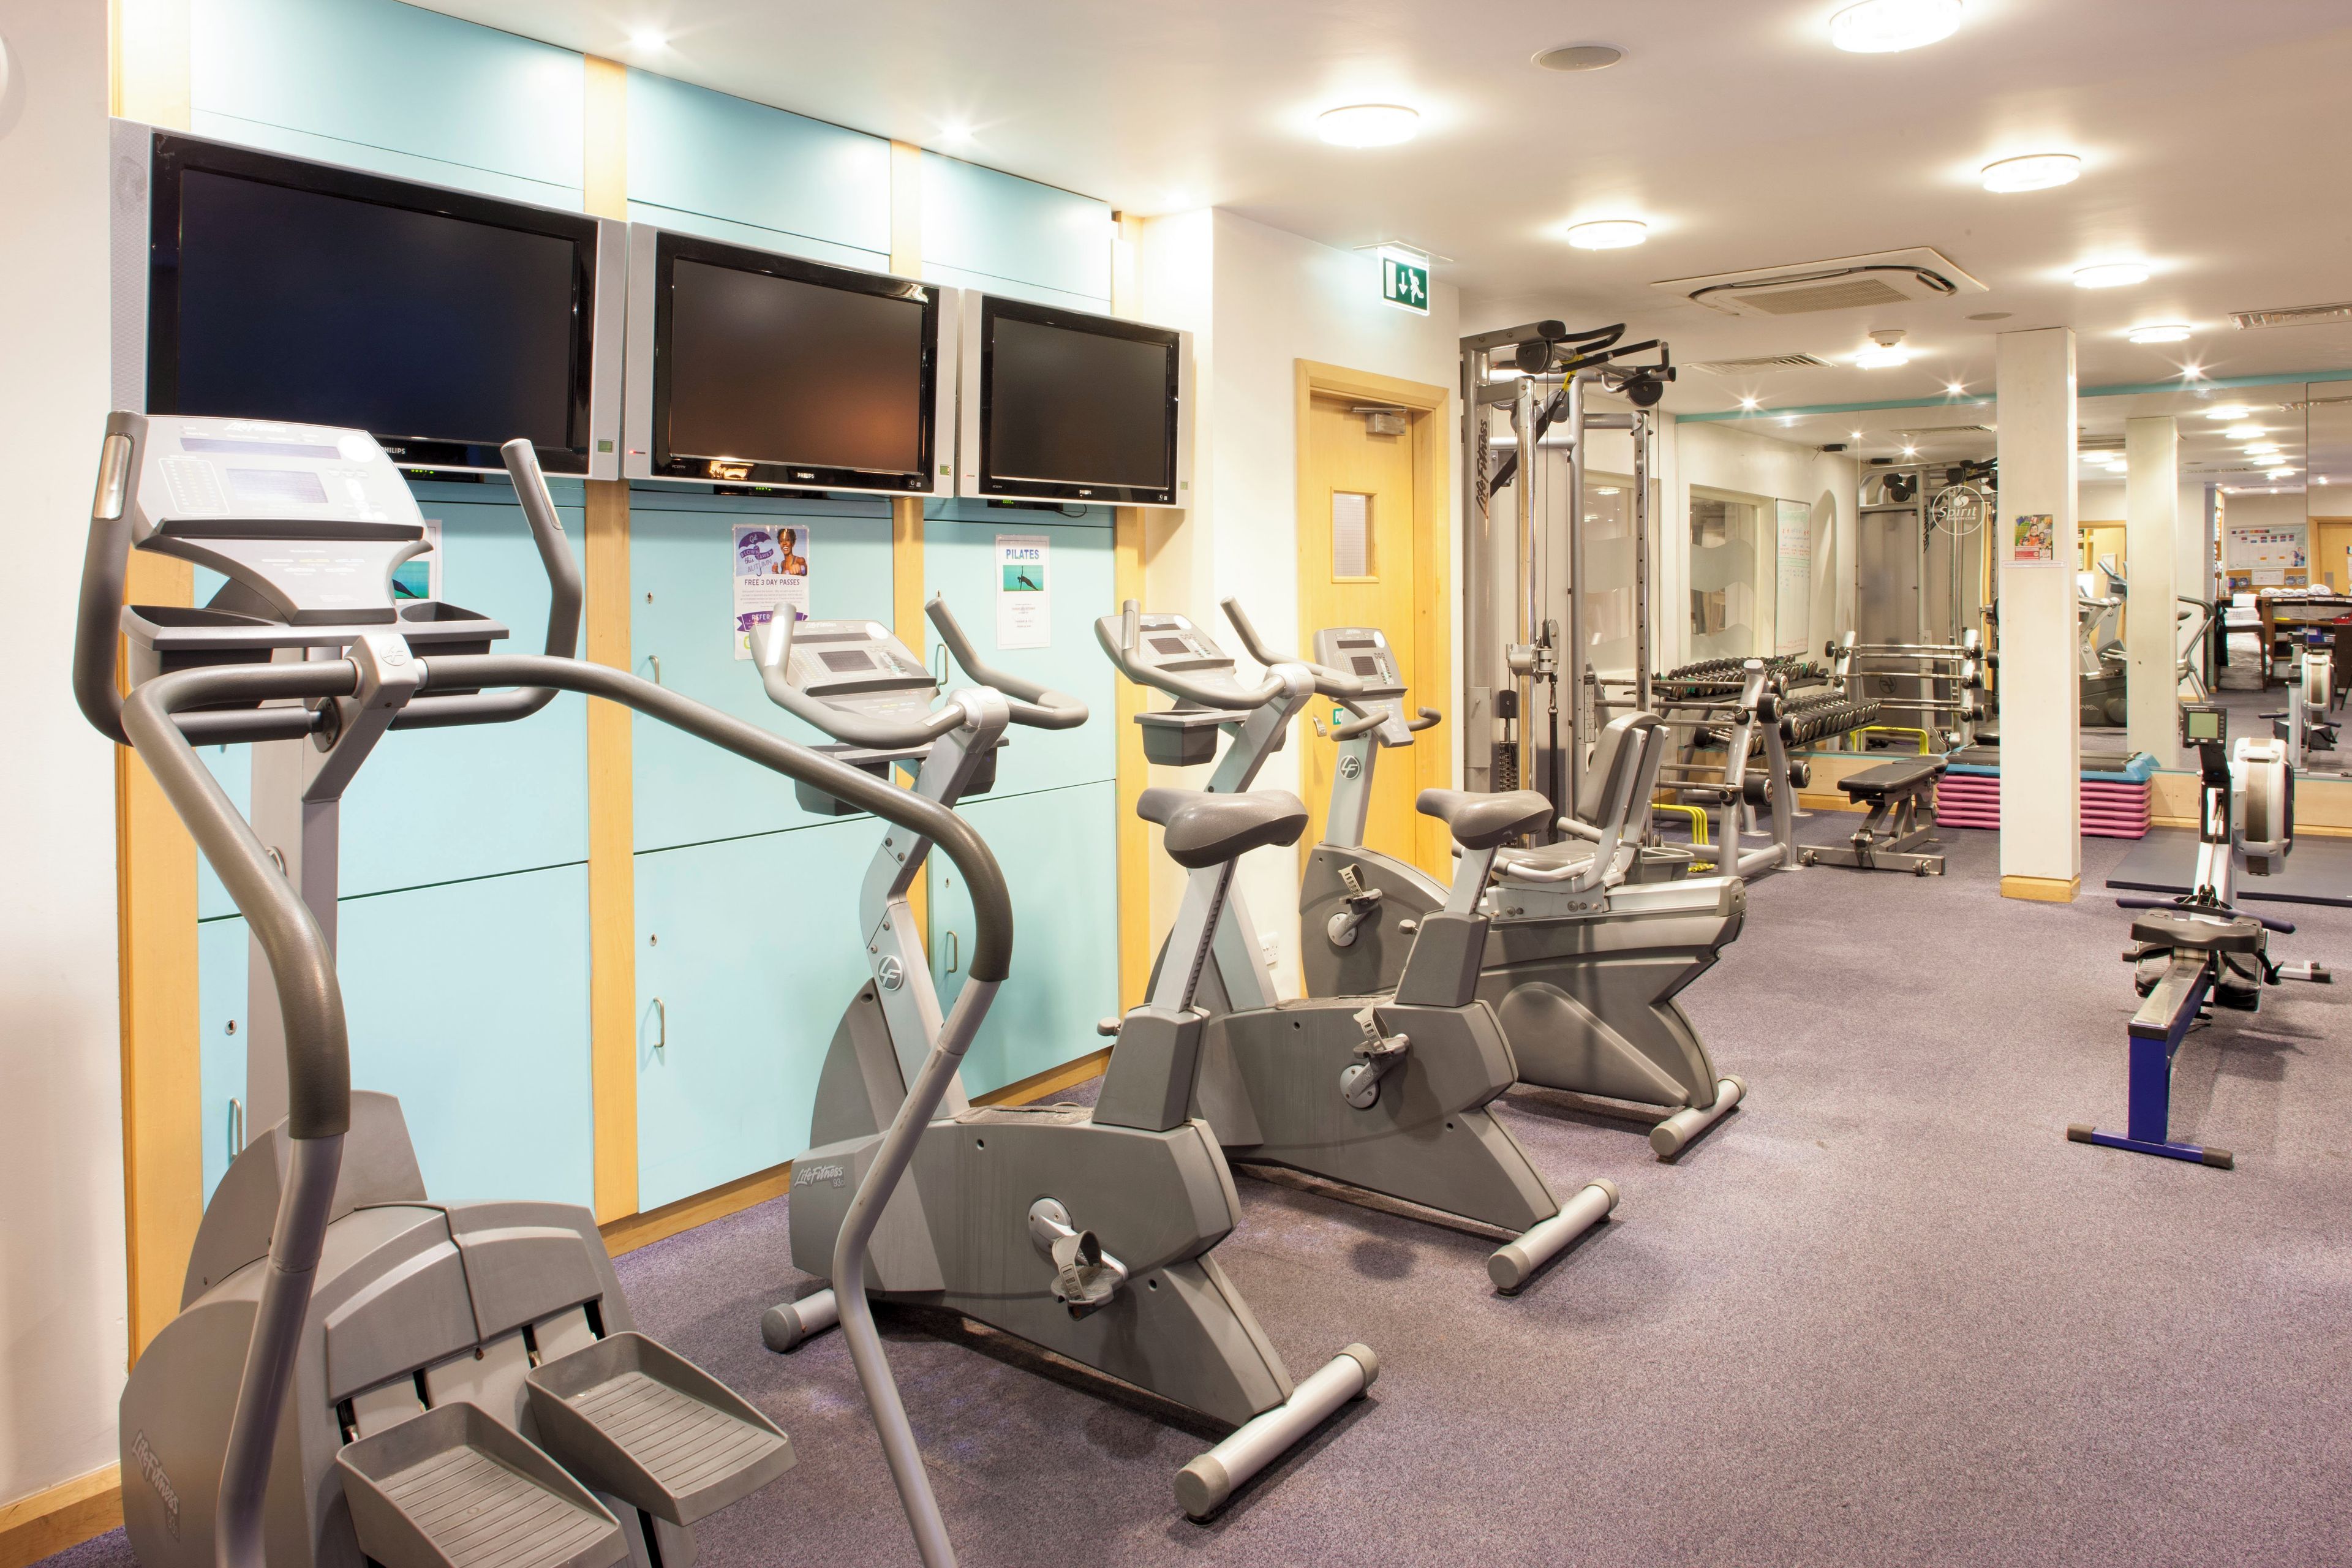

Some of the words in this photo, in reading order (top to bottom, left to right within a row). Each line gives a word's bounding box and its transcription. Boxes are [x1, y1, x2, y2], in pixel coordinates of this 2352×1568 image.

[1937, 506, 1977, 521] Spirit
[749, 534, 758, 543] Get
[760, 551, 774, 559] AWAY
[1006, 549, 1039, 560] PILATES
[747, 559, 772, 573] AUTUMN
[794, 1165, 843, 1186] LifeFitness
